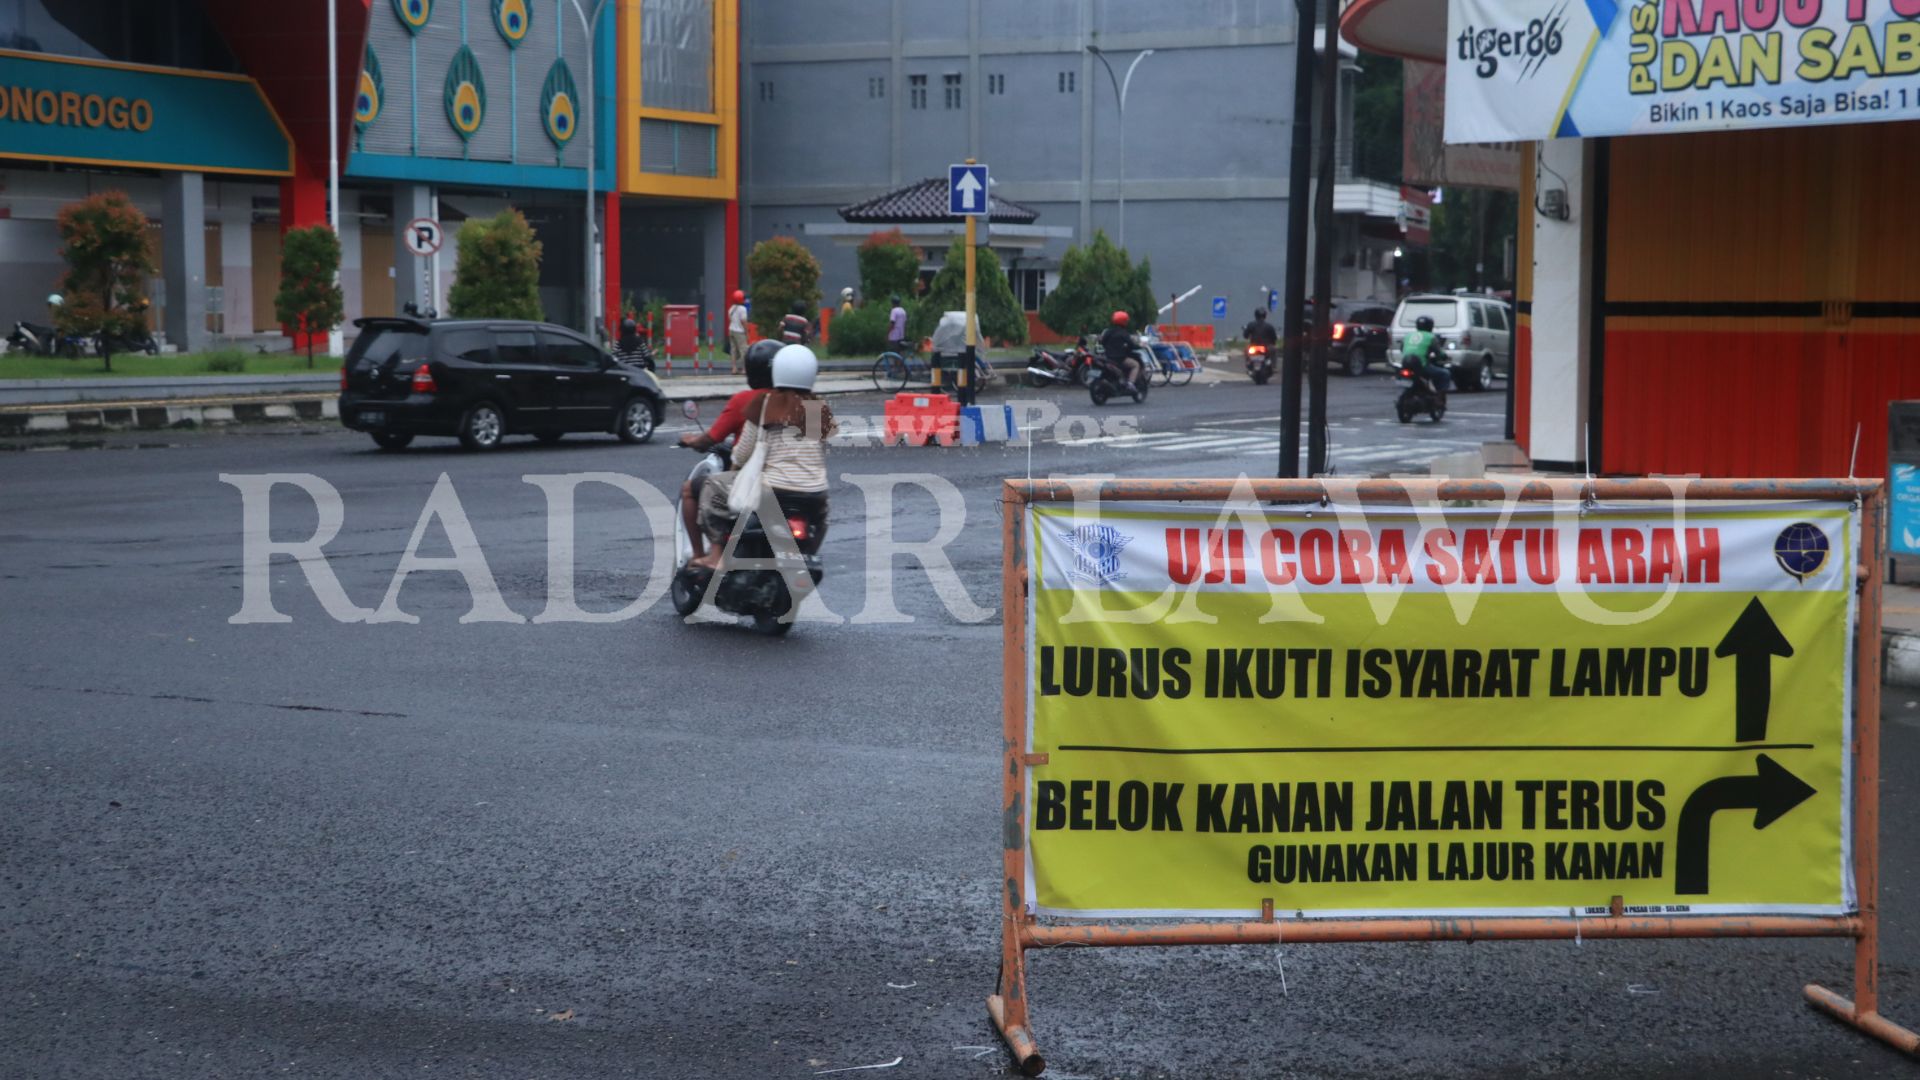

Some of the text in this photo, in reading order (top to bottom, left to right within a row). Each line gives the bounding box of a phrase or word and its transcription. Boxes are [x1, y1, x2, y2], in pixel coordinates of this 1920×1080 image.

[1457, 18, 1562, 78] tiger86
[1628, 0, 1660, 95] PUS
[1660, 31, 1782, 92] DAN
[1650, 102, 1698, 122] Bikin
[1705, 101, 1714, 119] 1
[1721, 99, 1772, 119] Kaos
[1780, 93, 1826, 117] Saja
[1834, 90, 1889, 112] Bisa!
[1898, 88, 1907, 108] 1
[1165, 527, 1721, 585] UJI COBA SATU ARAH
[1040, 646, 1710, 699] LURUS IKUTI ISYARAT LAMPU
[1035, 779, 1667, 834] BELOK KANAN JALAN TERUS
[1247, 842, 1665, 884] GUNAKAN LAJUR KANAN
